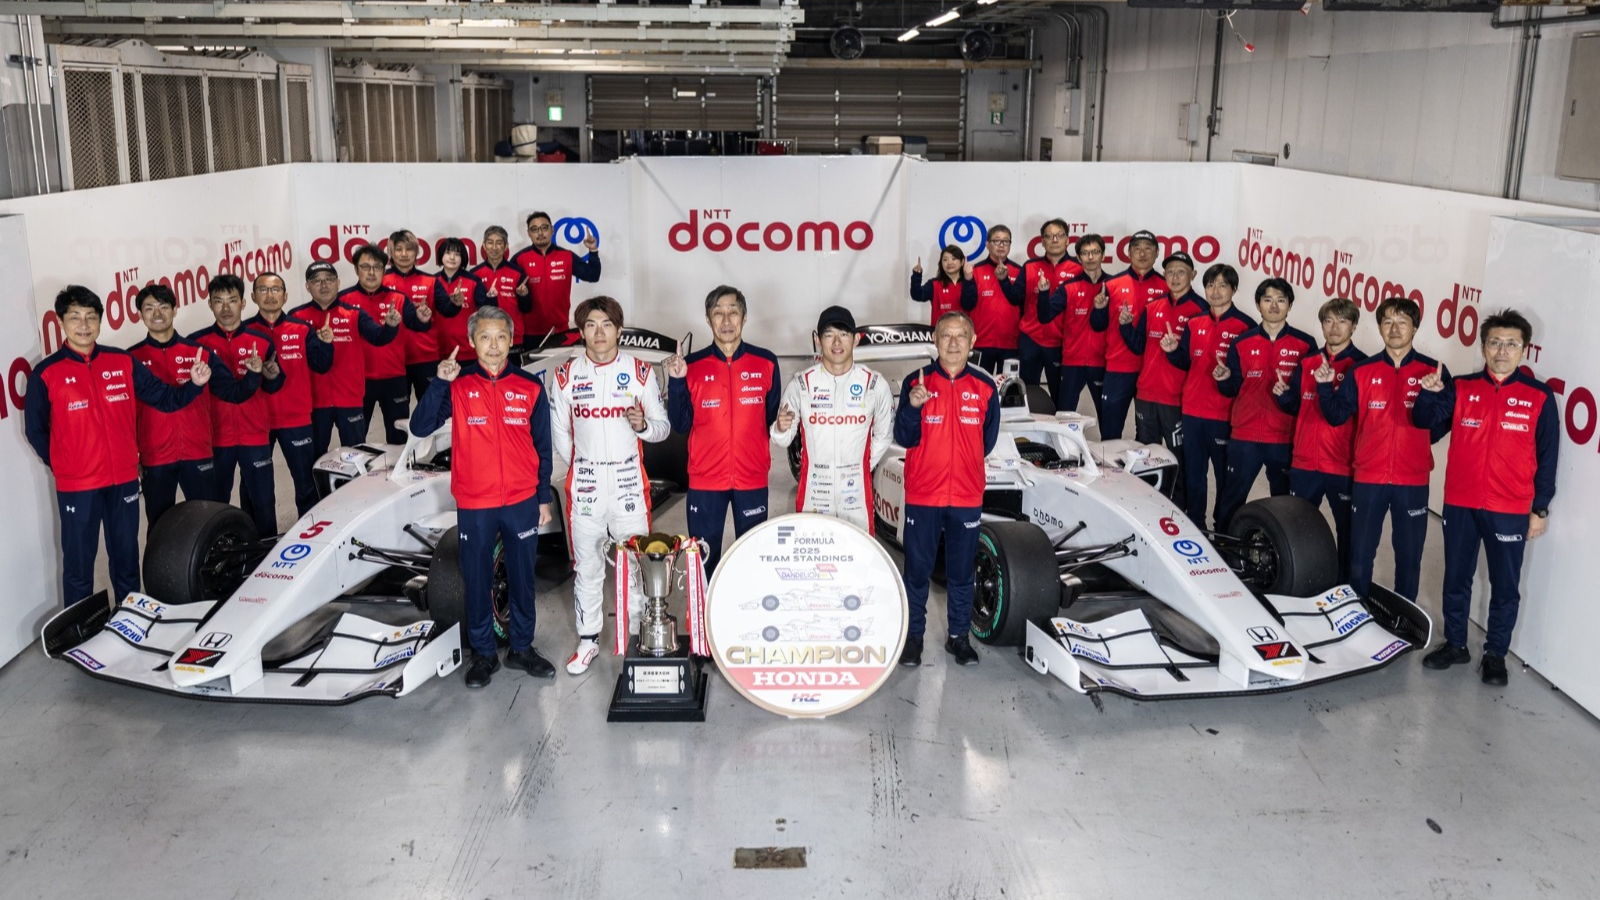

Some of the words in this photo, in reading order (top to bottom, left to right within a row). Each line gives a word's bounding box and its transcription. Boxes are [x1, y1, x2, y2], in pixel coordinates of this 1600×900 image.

[704, 210, 731, 219] NTT
[343, 225, 370, 234] NTT
[668, 210, 874, 251] docomo
[1252, 228, 1263, 240] NTT
[230, 240, 242, 252] NTT
[1238, 227, 1315, 289] docomo
[1340, 252, 1353, 266] NTT
[123, 267, 138, 283] NTT
[1462, 285, 1482, 303] NTT
[809, 412, 866, 425] docomo
[1033, 507, 1063, 529] ahamo
[300, 521, 333, 539] 5
[1160, 517, 1180, 536] 6
[272, 561, 297, 569] NTT
[1188, 557, 1210, 565] NTT
[255, 572, 293, 580] docomo
[1190, 568, 1227, 576] docomo
[1326, 587, 1352, 603] KSE
[137, 598, 166, 613] KSE
[1338, 612, 1370, 635] ITOCHU
[110, 620, 143, 643] ITOCHU
[726, 646, 887, 665] CHAMPION
[753, 672, 860, 686] HONDA
[792, 694, 821, 703] HRC
